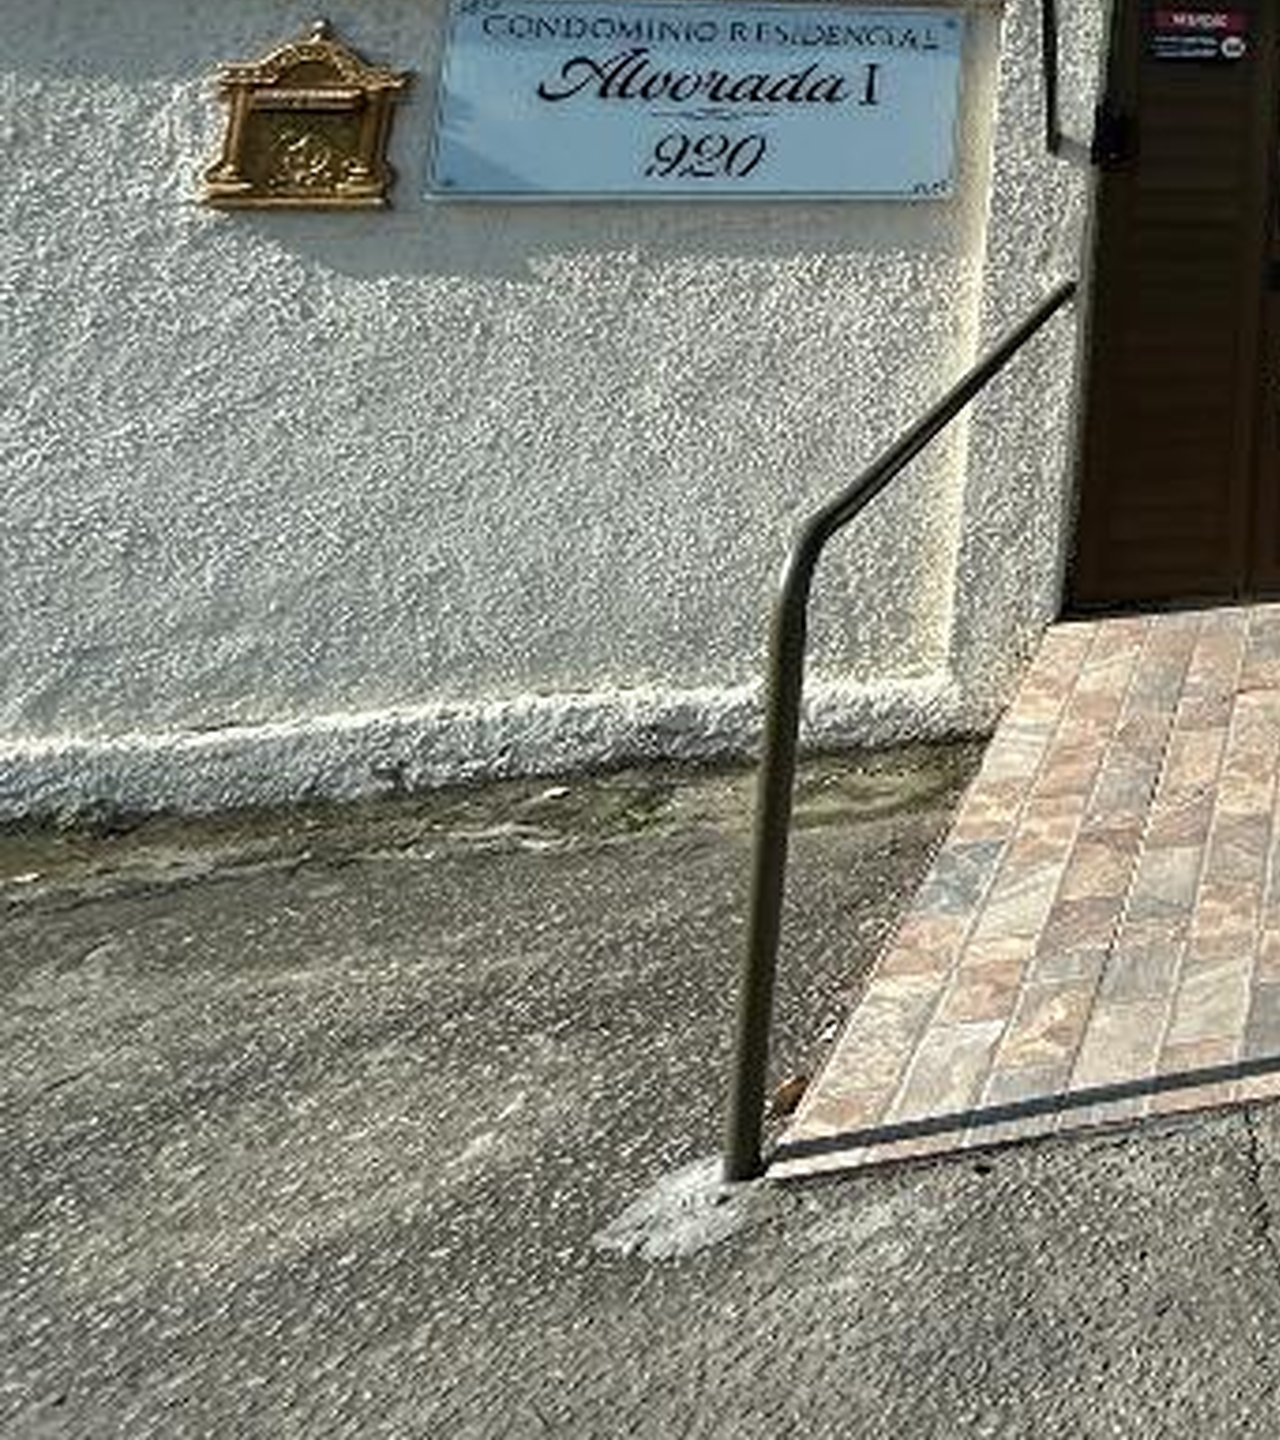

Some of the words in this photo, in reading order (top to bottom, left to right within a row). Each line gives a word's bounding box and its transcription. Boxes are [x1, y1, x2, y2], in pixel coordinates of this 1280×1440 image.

[729, 20, 939, 50] RESIDENCIAL
[537, 47, 851, 104] Alvorada
[858, 63, 880, 106] I
[645, 133, 767, 178] 920
